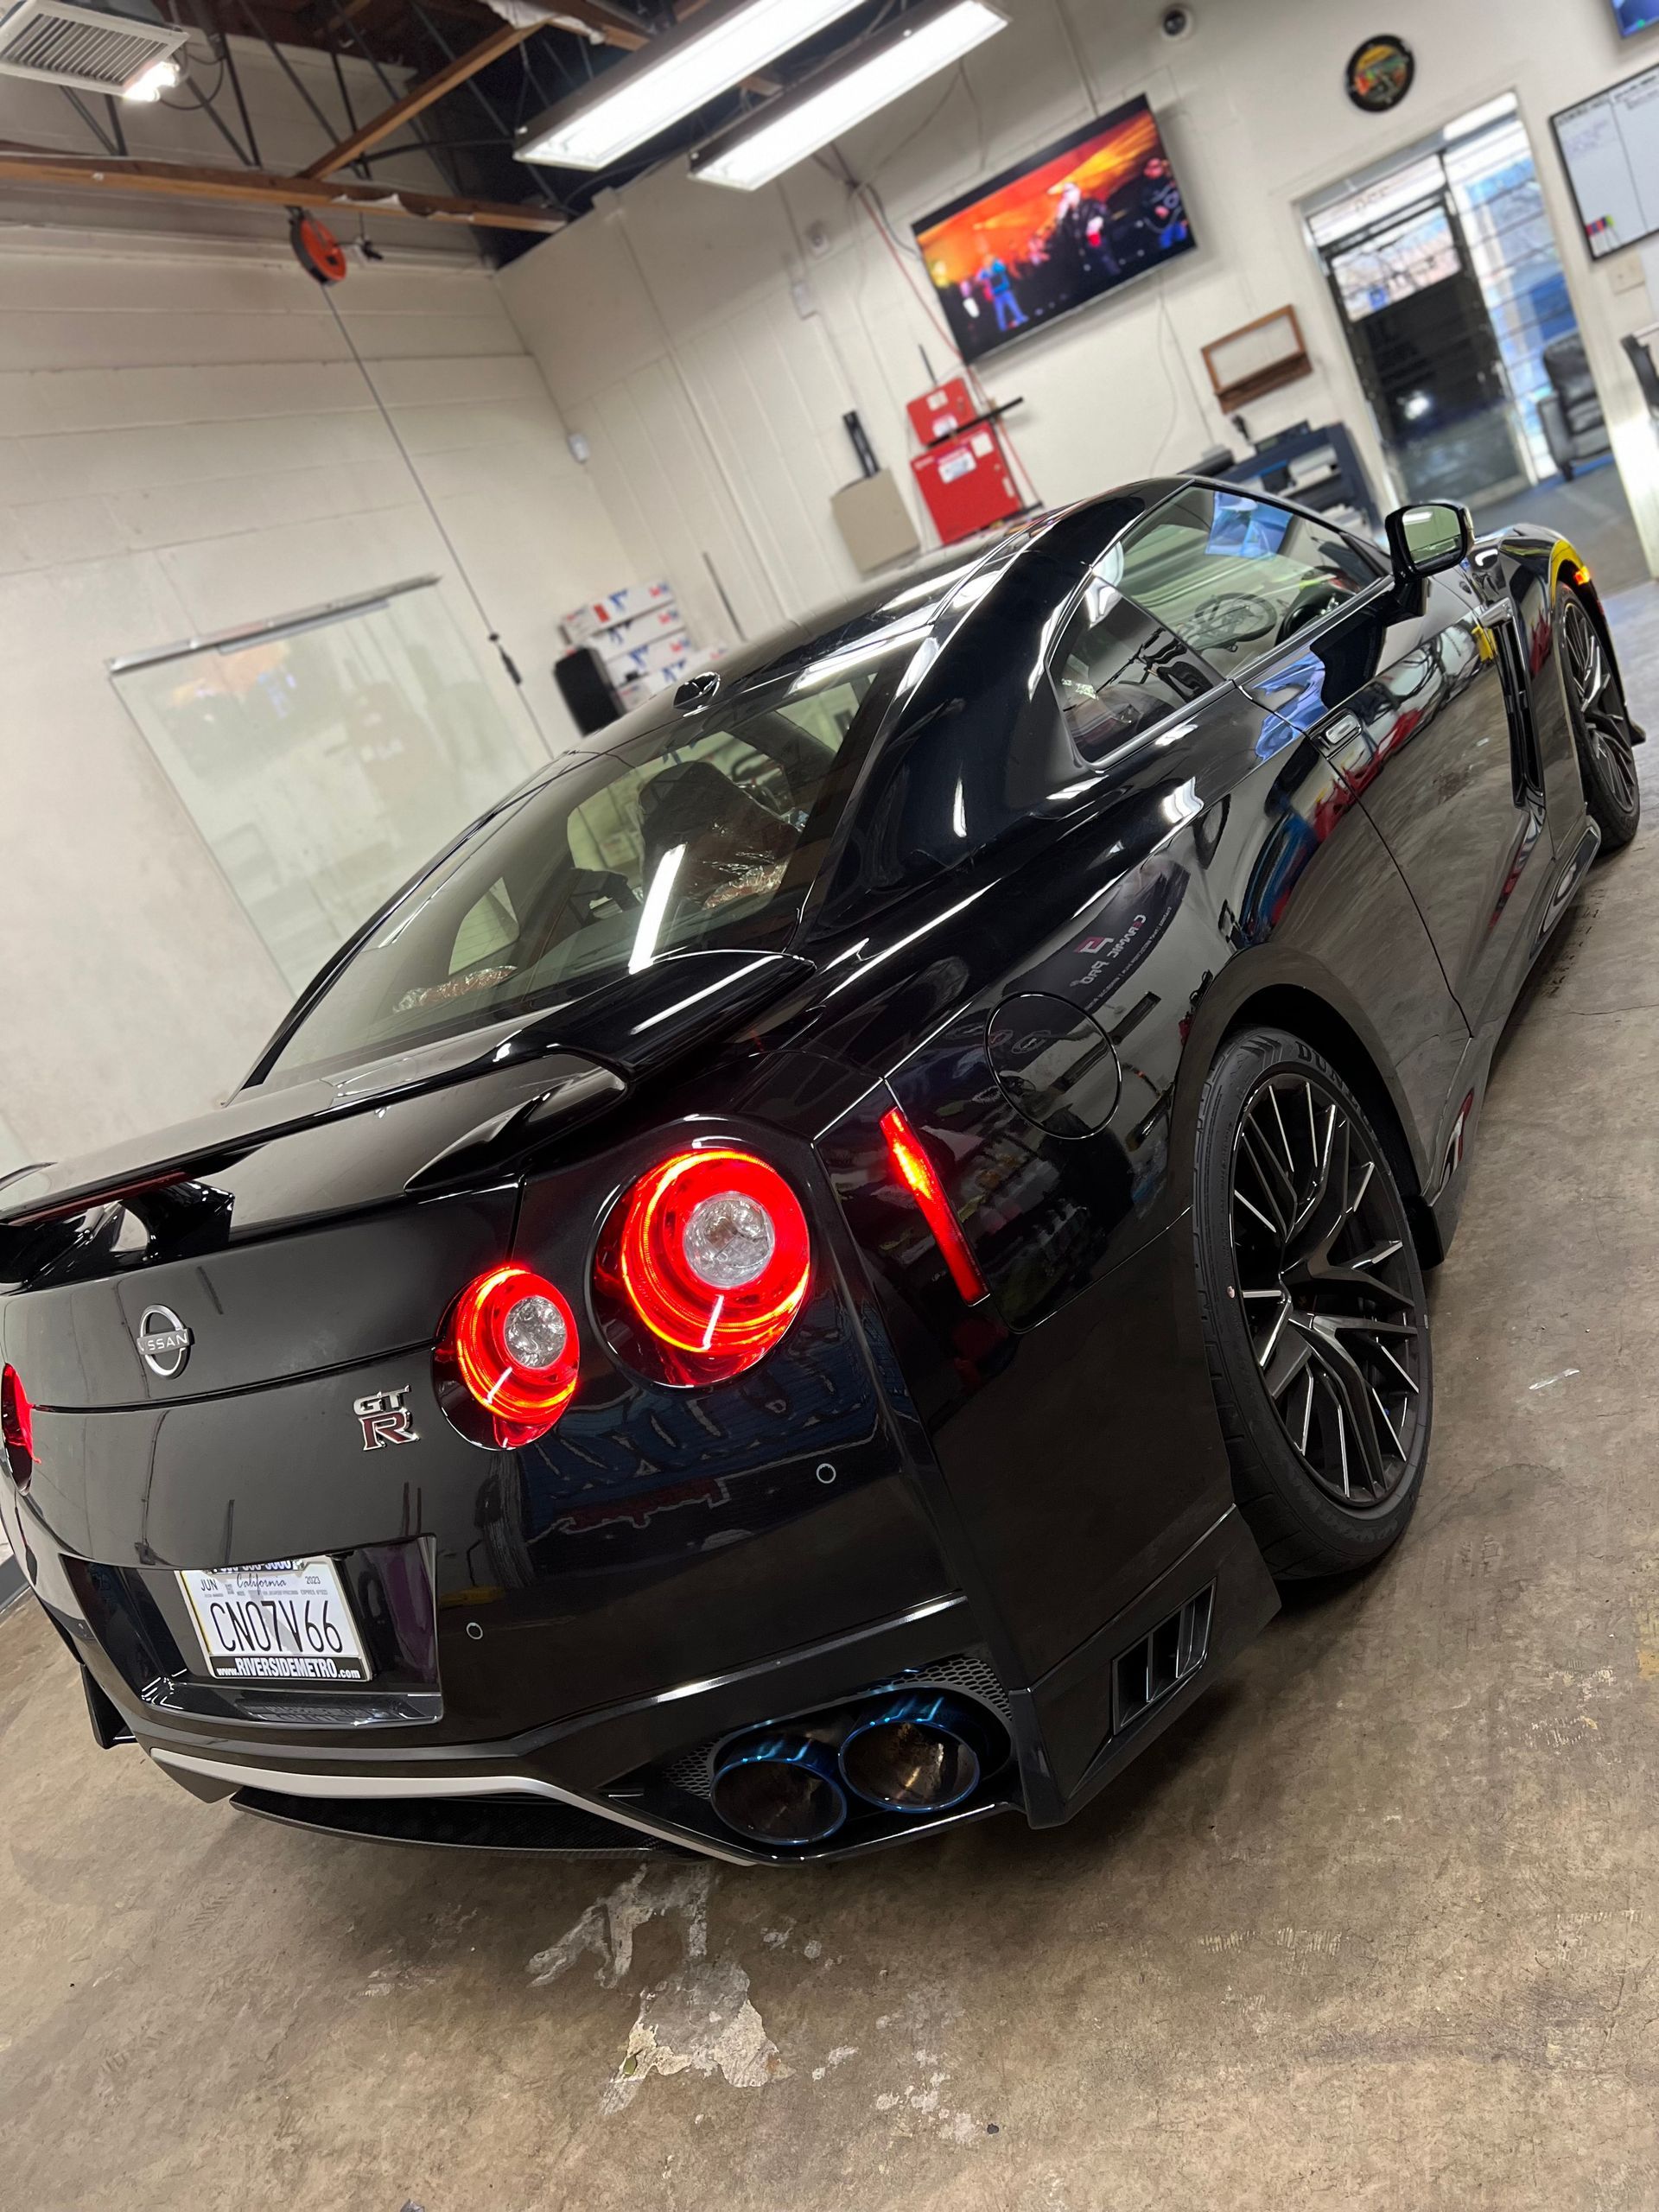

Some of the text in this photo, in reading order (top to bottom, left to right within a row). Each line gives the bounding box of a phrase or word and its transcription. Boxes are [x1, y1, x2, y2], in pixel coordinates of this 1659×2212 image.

[353, 1385, 411, 1415] GT
[359, 1408, 420, 1451] R
[200, 1579, 218, 1591] JUN
[237, 1573, 288, 1595] California
[305, 1576, 321, 1585] 2023
[210, 1600, 343, 1653] CN07V66
[216, 1657, 361, 1679] www.RIVERSIDEMETRO.com
